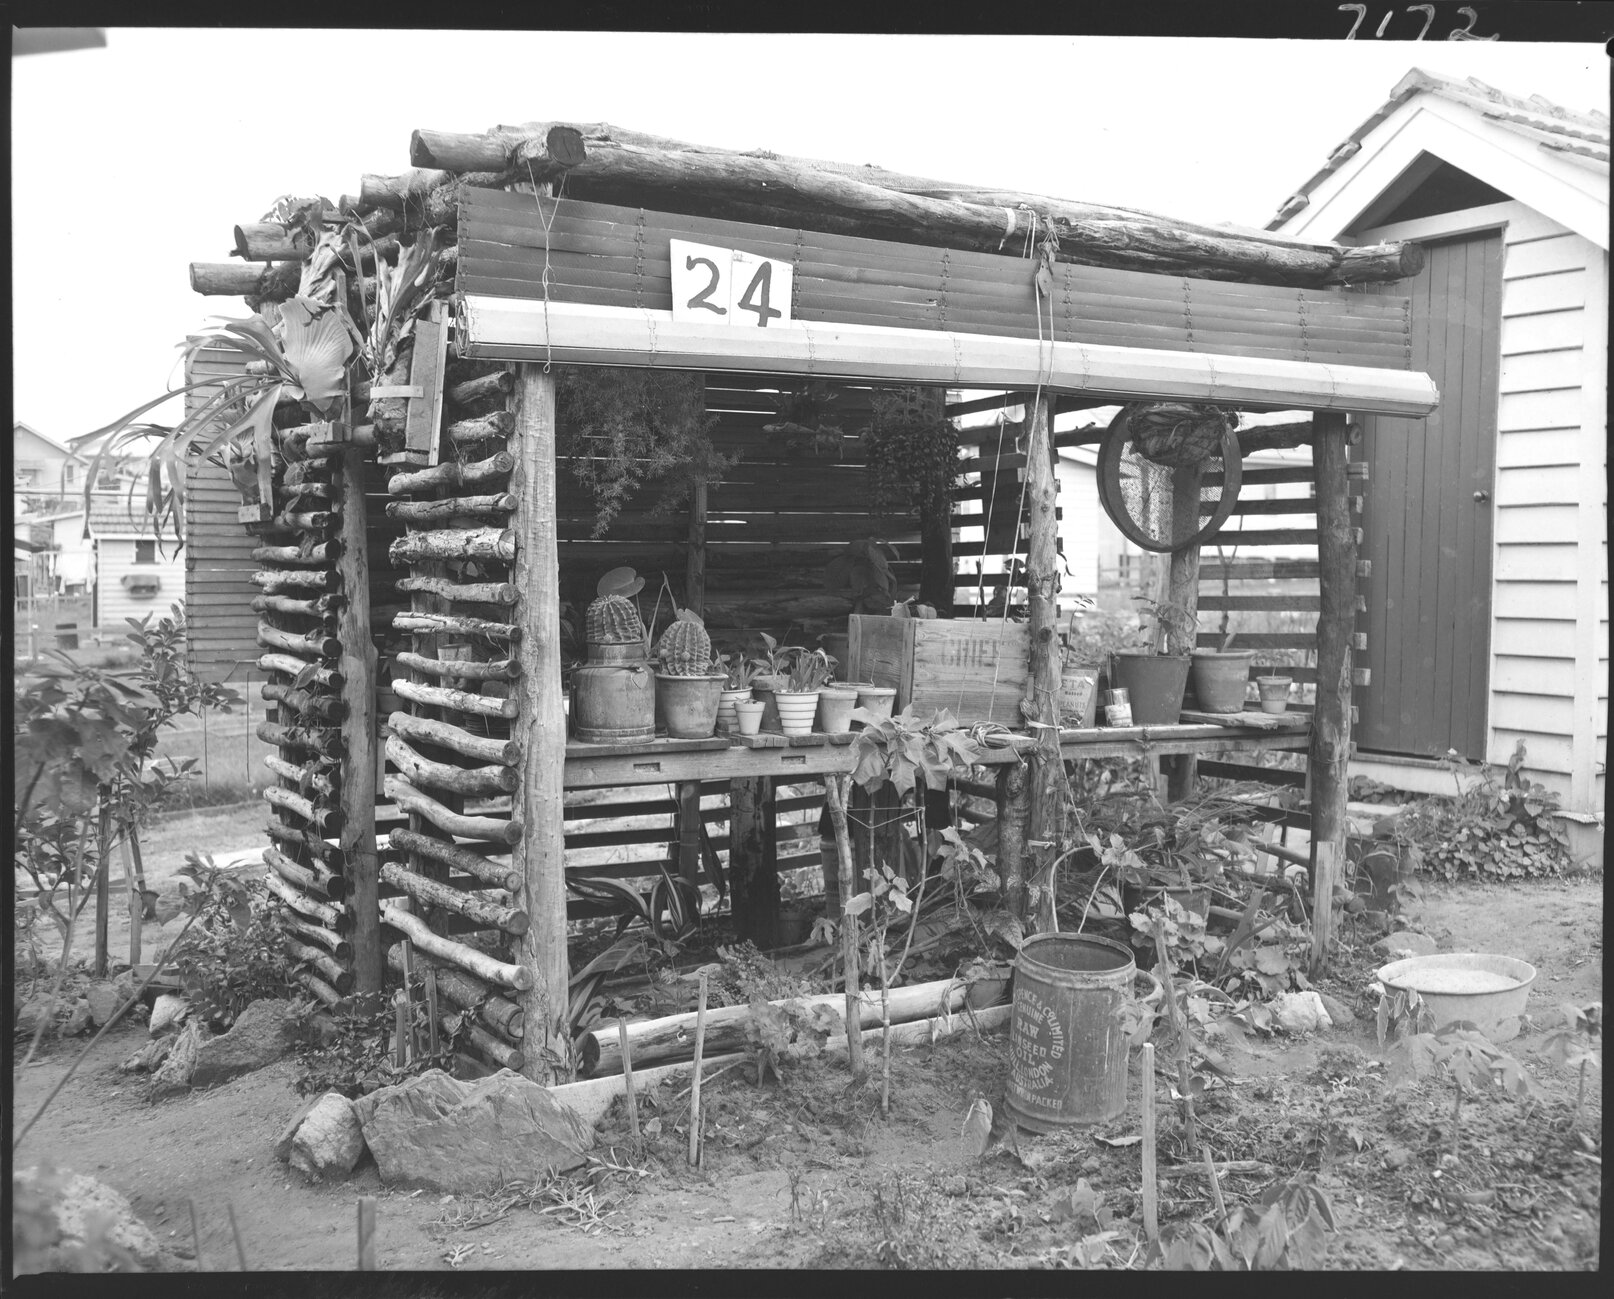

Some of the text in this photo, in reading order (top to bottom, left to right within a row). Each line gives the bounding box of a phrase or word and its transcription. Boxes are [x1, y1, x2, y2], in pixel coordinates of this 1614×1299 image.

[1338, 3, 1500, 41] 7172
[686, 255, 782, 327] 24
[1016, 1016, 1040, 1040] RAW
[1047, 1016, 1065, 1059] LIMITED
[1012, 1030, 1047, 1057] LINSEED
[1016, 1046, 1035, 1066] OIL
[1031, 1094, 1063, 1110] PACKED
